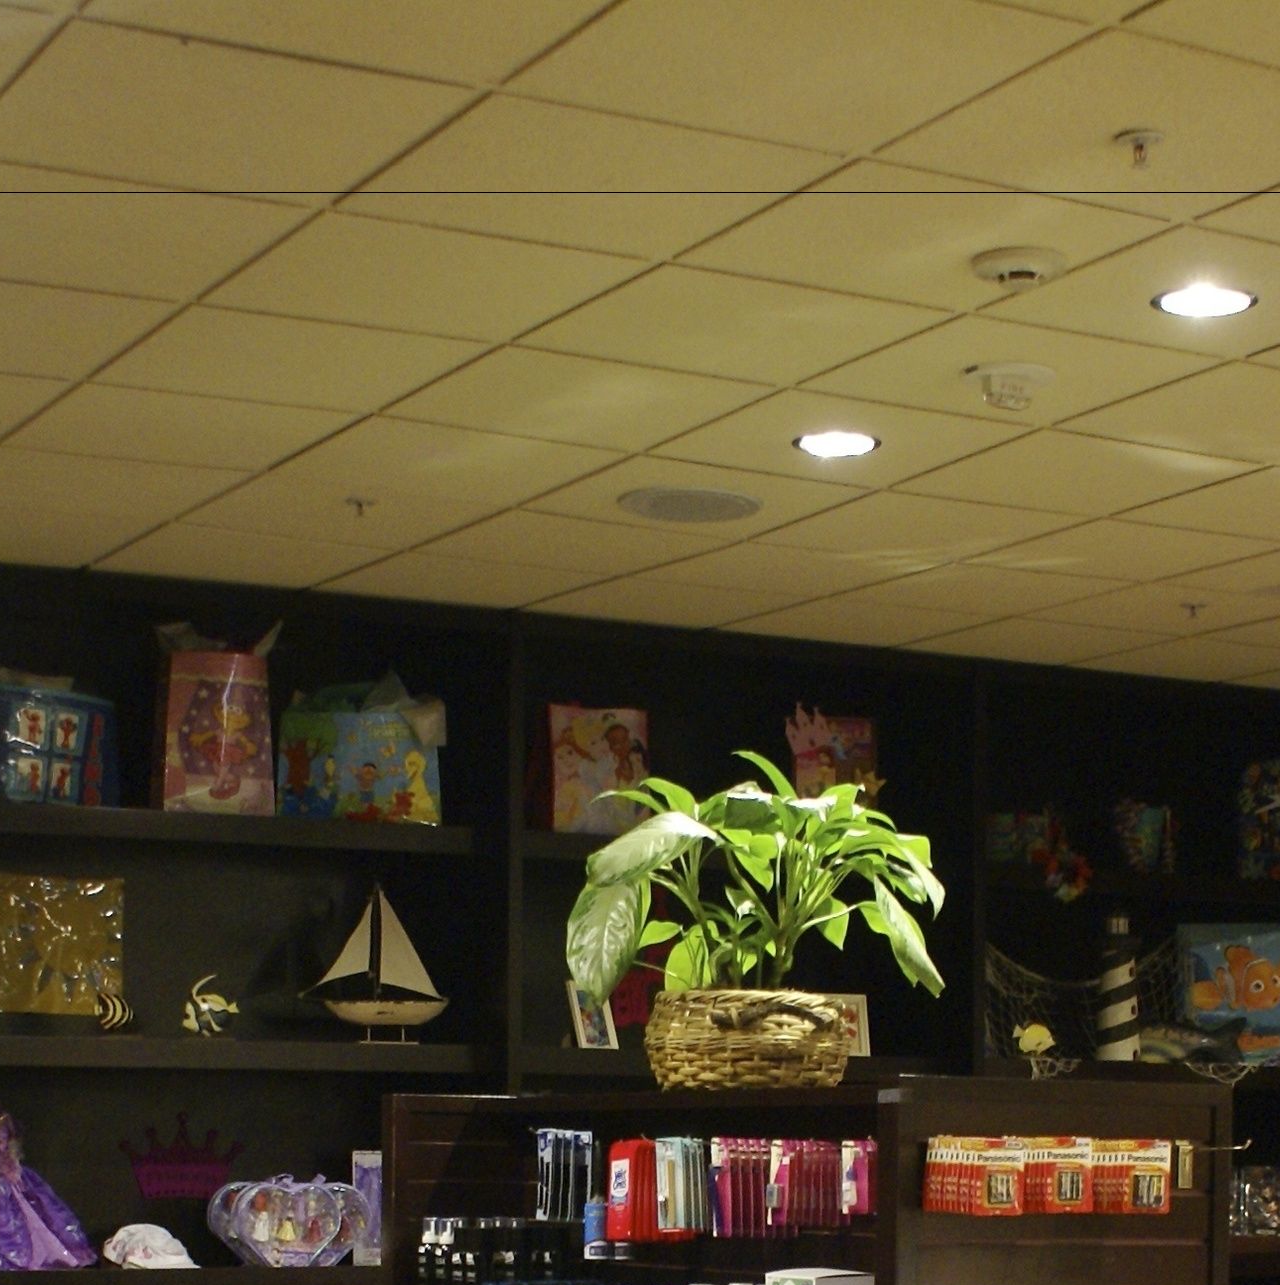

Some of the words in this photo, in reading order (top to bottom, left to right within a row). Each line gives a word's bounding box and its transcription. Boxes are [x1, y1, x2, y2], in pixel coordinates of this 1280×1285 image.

[977, 1153, 1021, 1163] Panasonic
[1047, 1151, 1089, 1161] Panasonic
[1127, 1153, 1168, 1164] Panasonic
